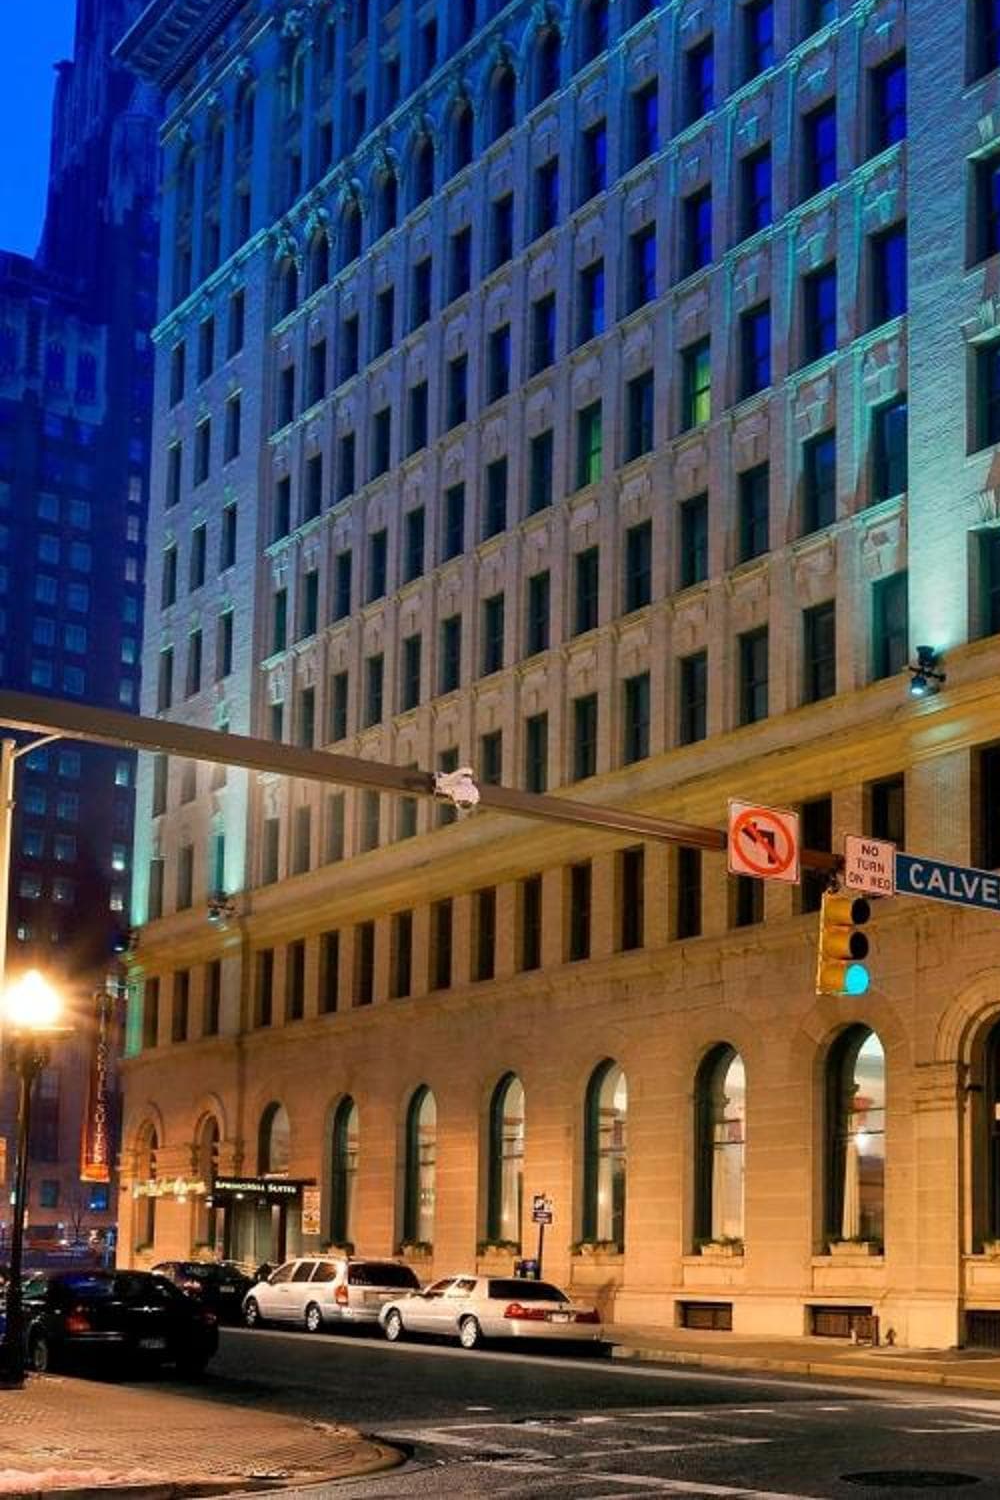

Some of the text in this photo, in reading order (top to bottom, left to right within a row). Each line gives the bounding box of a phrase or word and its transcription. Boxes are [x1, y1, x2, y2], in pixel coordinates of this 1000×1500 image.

[861, 843, 879, 857] NO
[857, 858, 885, 874] TURN
[848, 871, 890, 890] ON RED
